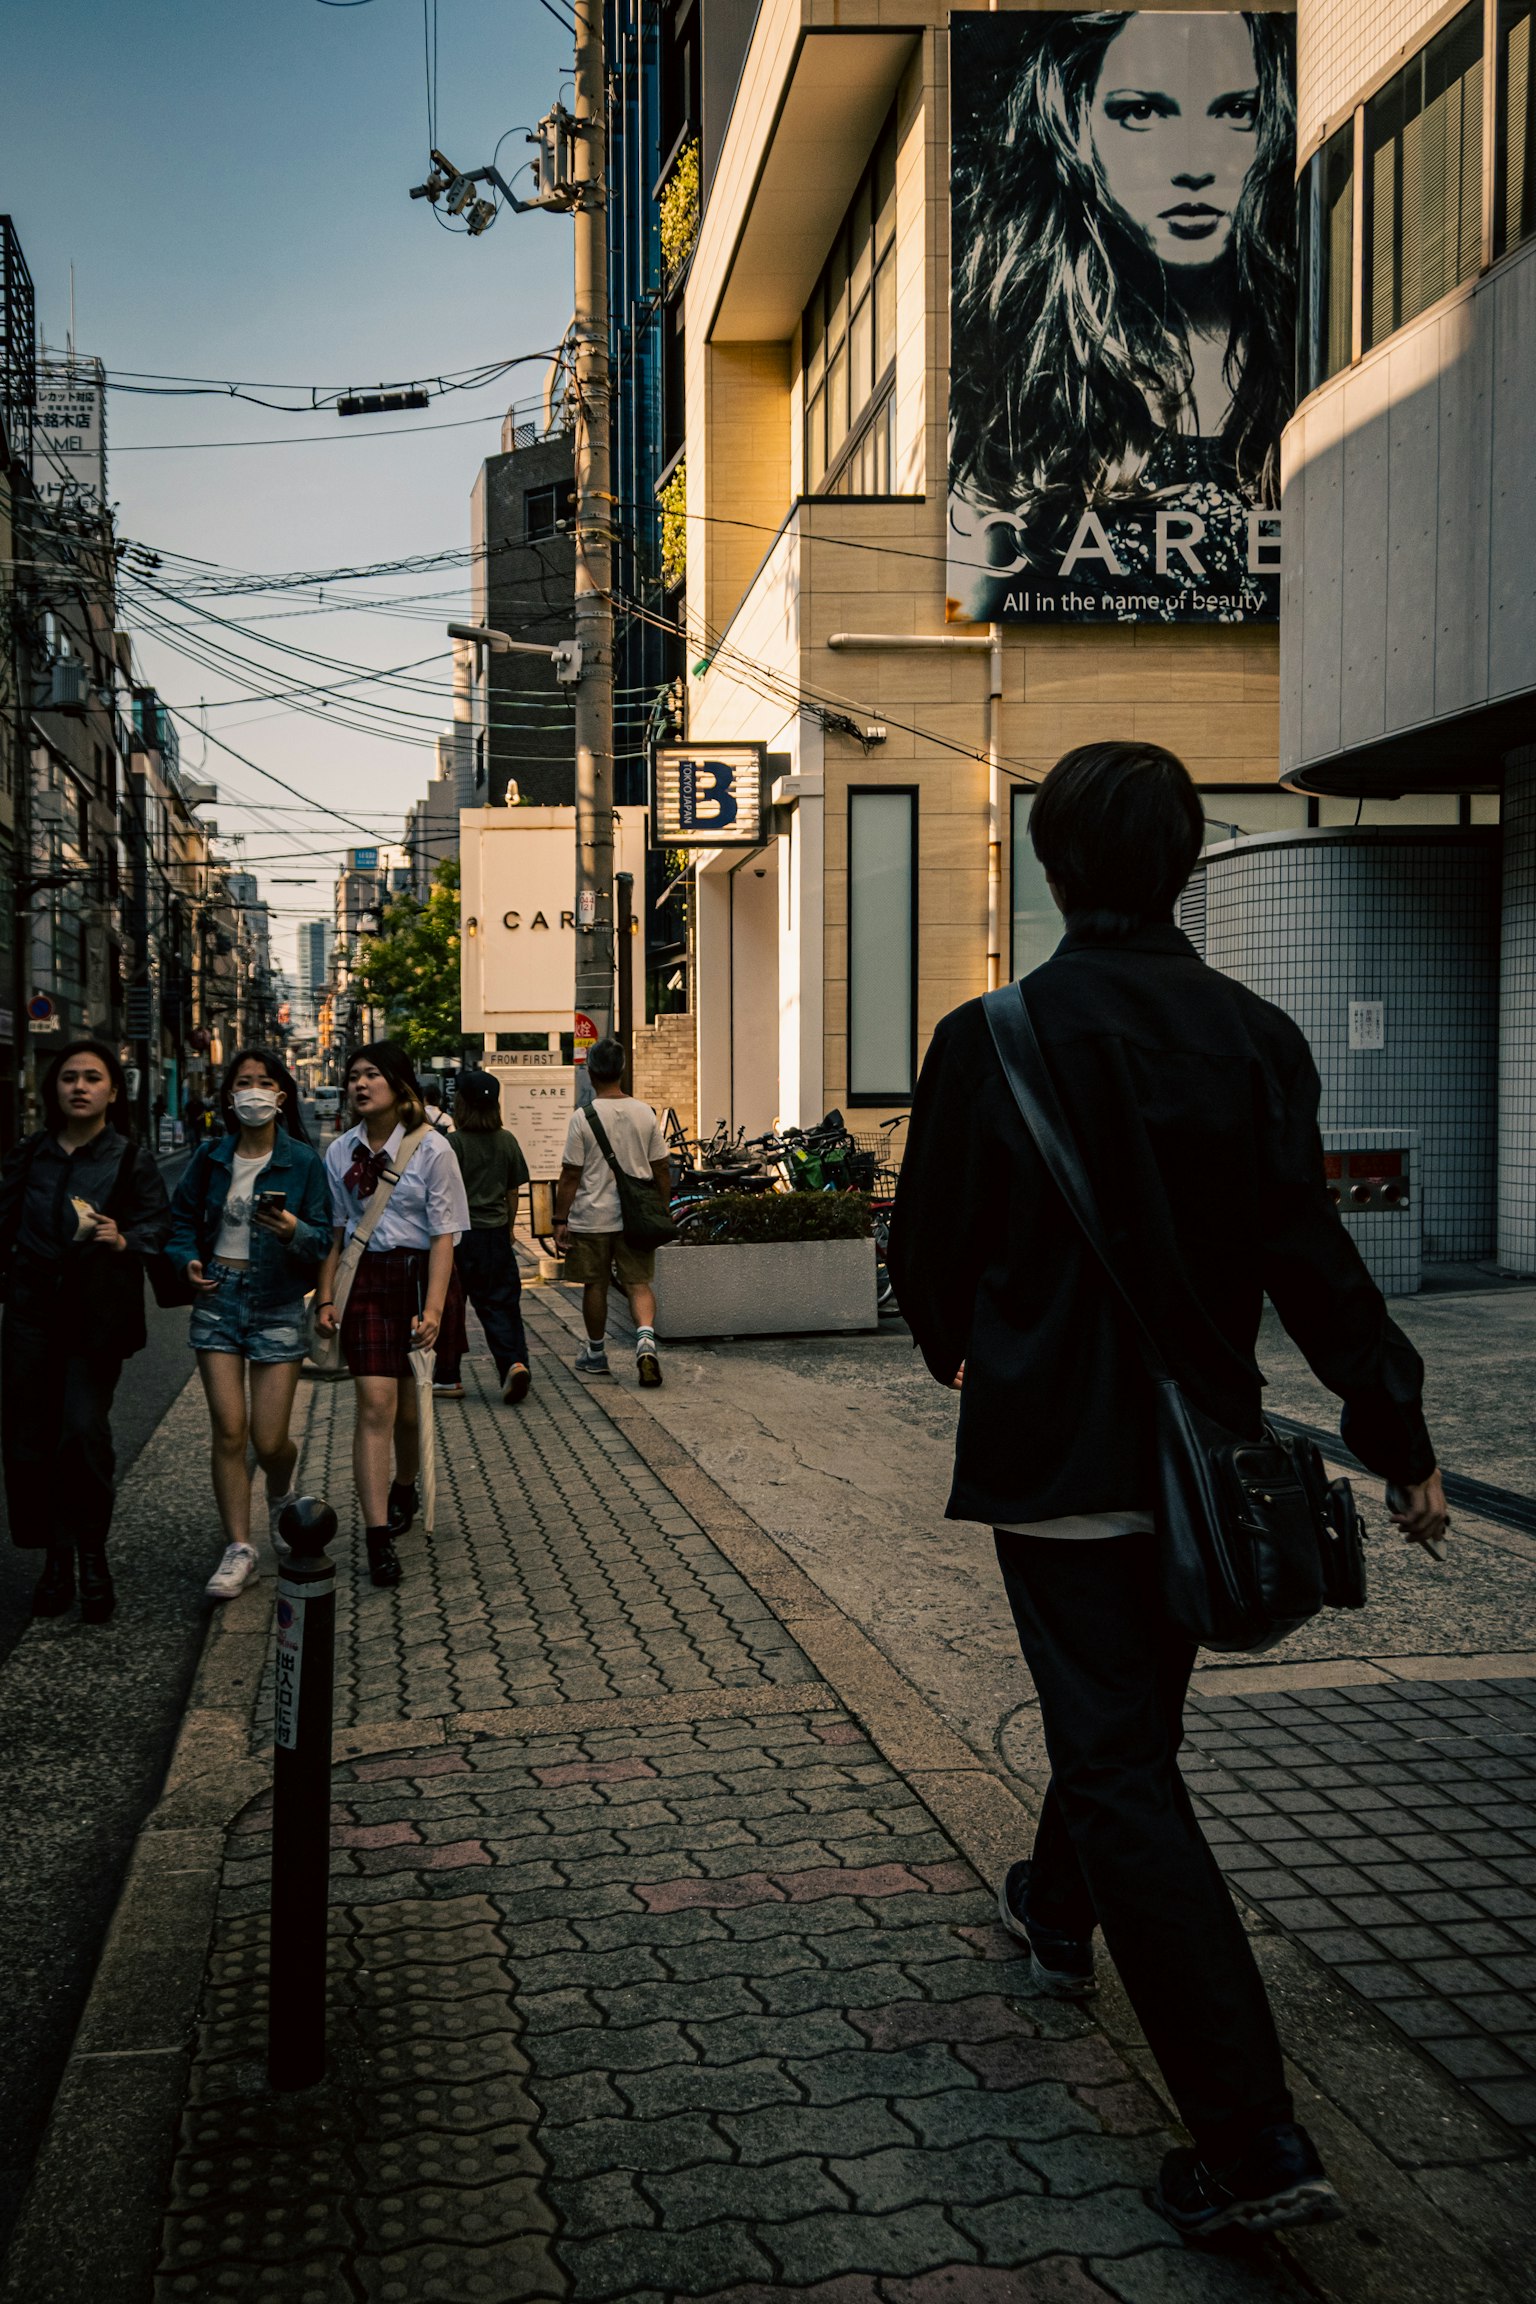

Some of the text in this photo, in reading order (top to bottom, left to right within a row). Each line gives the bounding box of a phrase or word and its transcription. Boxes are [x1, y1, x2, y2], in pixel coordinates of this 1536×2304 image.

[971, 511, 1281, 578] CARE
[1003, 590, 1265, 612] All in the name of beauty
[679, 761, 738, 829] B
[683, 762, 692, 824] TOKYO JAPAN
[503, 911, 575, 930] CAR
[490, 1053, 555, 1065] FROM FIRST
[530, 1088, 567, 1097] CARE
[279, 1653, 295, 1743] 出入口に付
